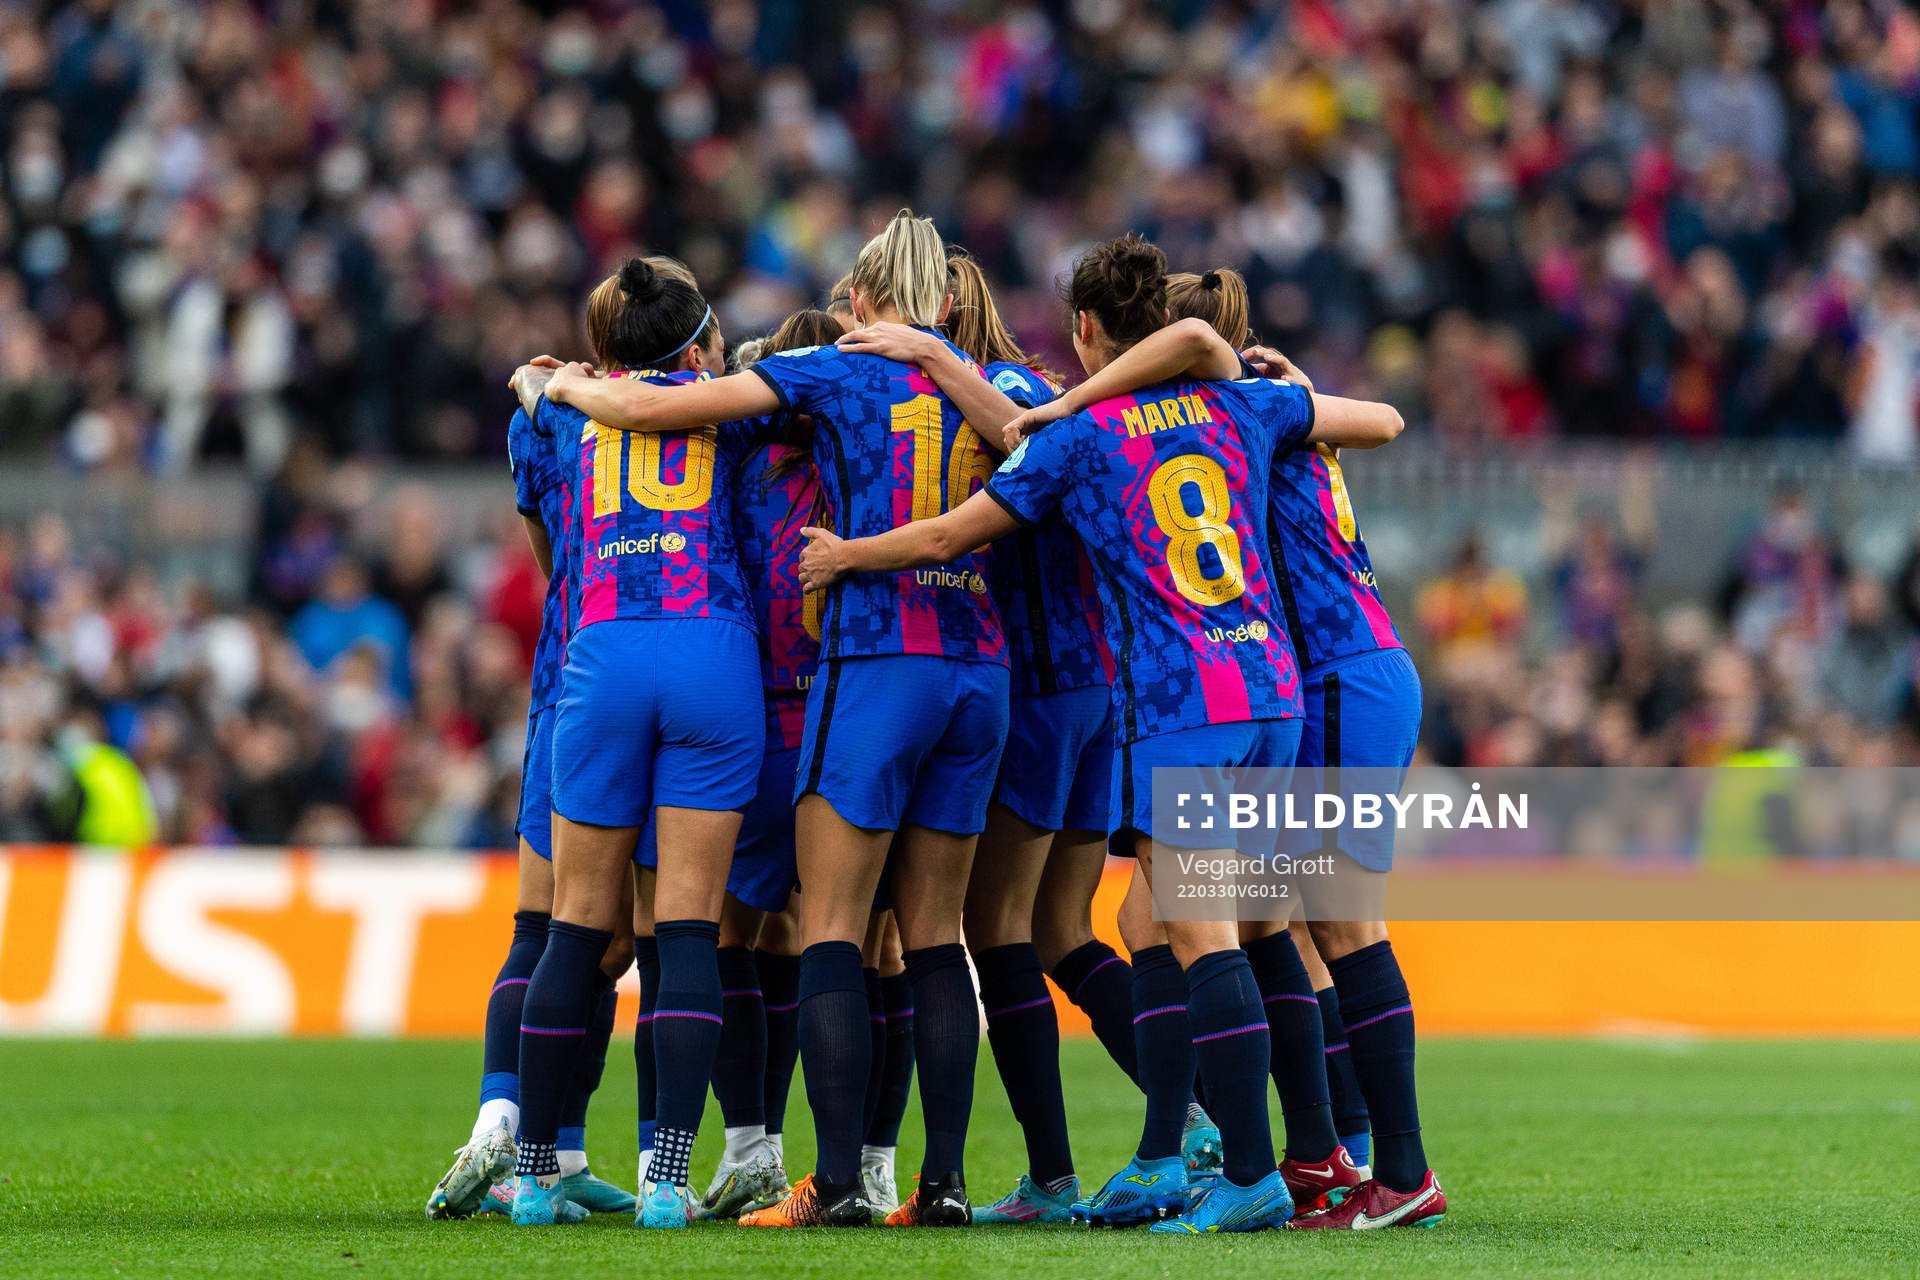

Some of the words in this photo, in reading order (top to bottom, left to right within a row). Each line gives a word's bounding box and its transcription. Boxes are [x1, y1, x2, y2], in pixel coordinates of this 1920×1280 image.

[1120, 393, 1213, 439] MARTA
[581, 419, 718, 519] 10
[598, 533, 659, 560] unicef
[1147, 453, 1246, 607] 8
[916, 567, 969, 590] unicef
